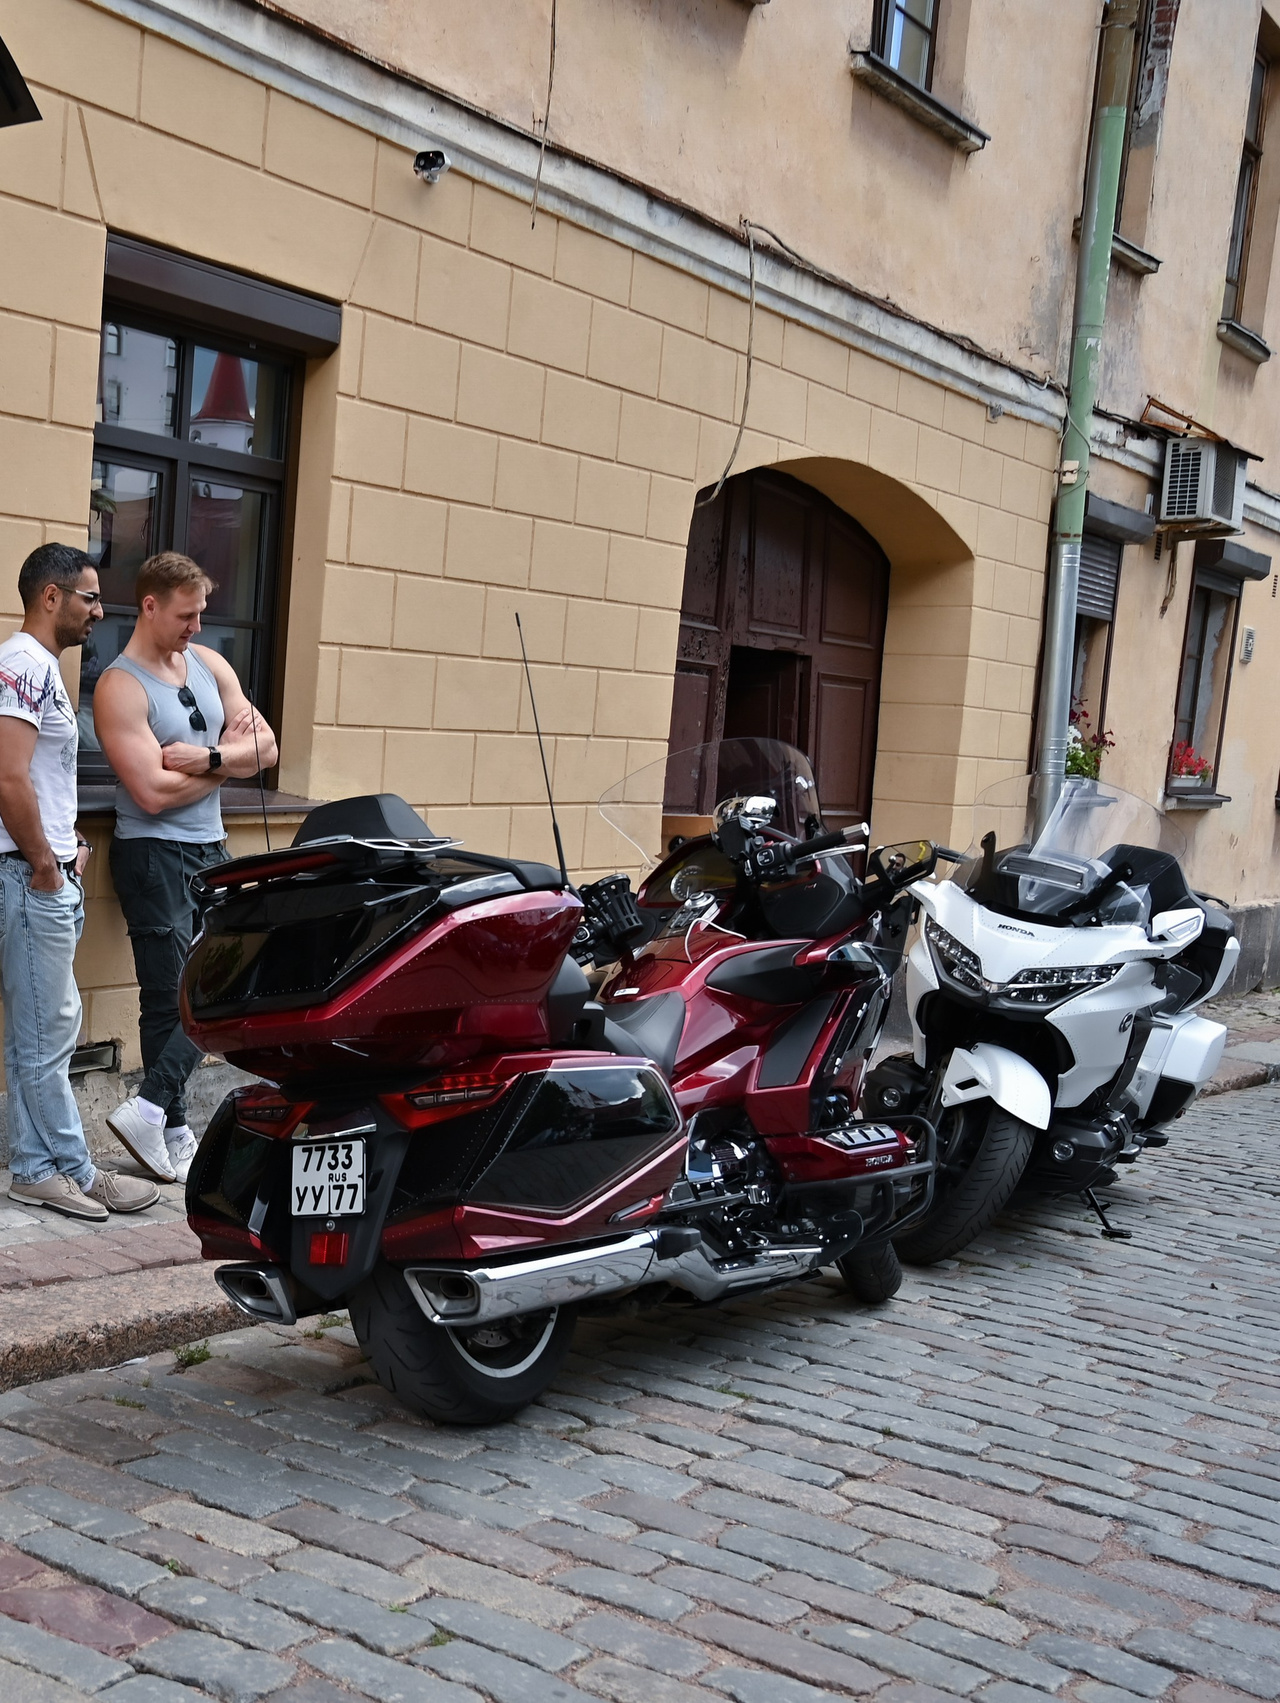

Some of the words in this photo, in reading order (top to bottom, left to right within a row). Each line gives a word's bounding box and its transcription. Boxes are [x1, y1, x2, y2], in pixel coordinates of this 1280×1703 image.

[997, 923, 1036, 938] HONDA
[301, 1144, 353, 1172] 7733
[865, 1154, 894, 1167] HONDA
[328, 1172, 347, 1182] RUS
[332, 1184, 359, 1211] 77
